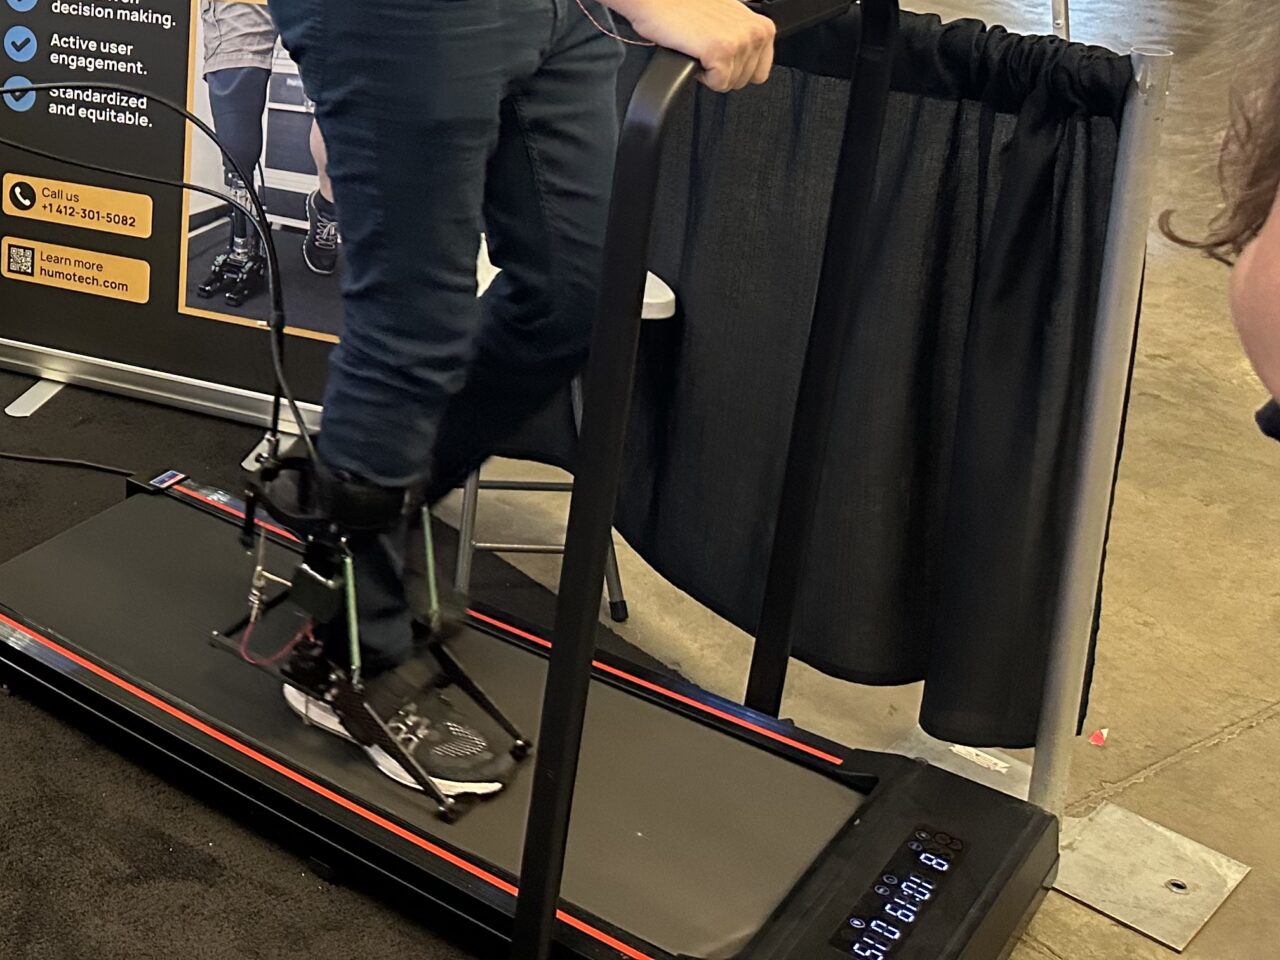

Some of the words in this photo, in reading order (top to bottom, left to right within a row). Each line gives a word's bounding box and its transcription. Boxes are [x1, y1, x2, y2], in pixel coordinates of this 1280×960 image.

[51, 0, 114, 19] decision
[116, 8, 177, 29] making.
[50, 33, 97, 52] Active
[100, 41, 133, 56] user
[49, 53, 148, 75] engagement.
[48, 102, 75, 117] and
[78, 106, 153, 128] equitable.
[41, 187, 63, 200] Call
[65, 192, 80, 203] us
[41, 203, 54, 214] +1
[55, 205, 136, 227] 412-301-5082
[40, 251, 71, 267] Learn
[74, 258, 104, 272] more
[39, 266, 129, 292] humotech.com
